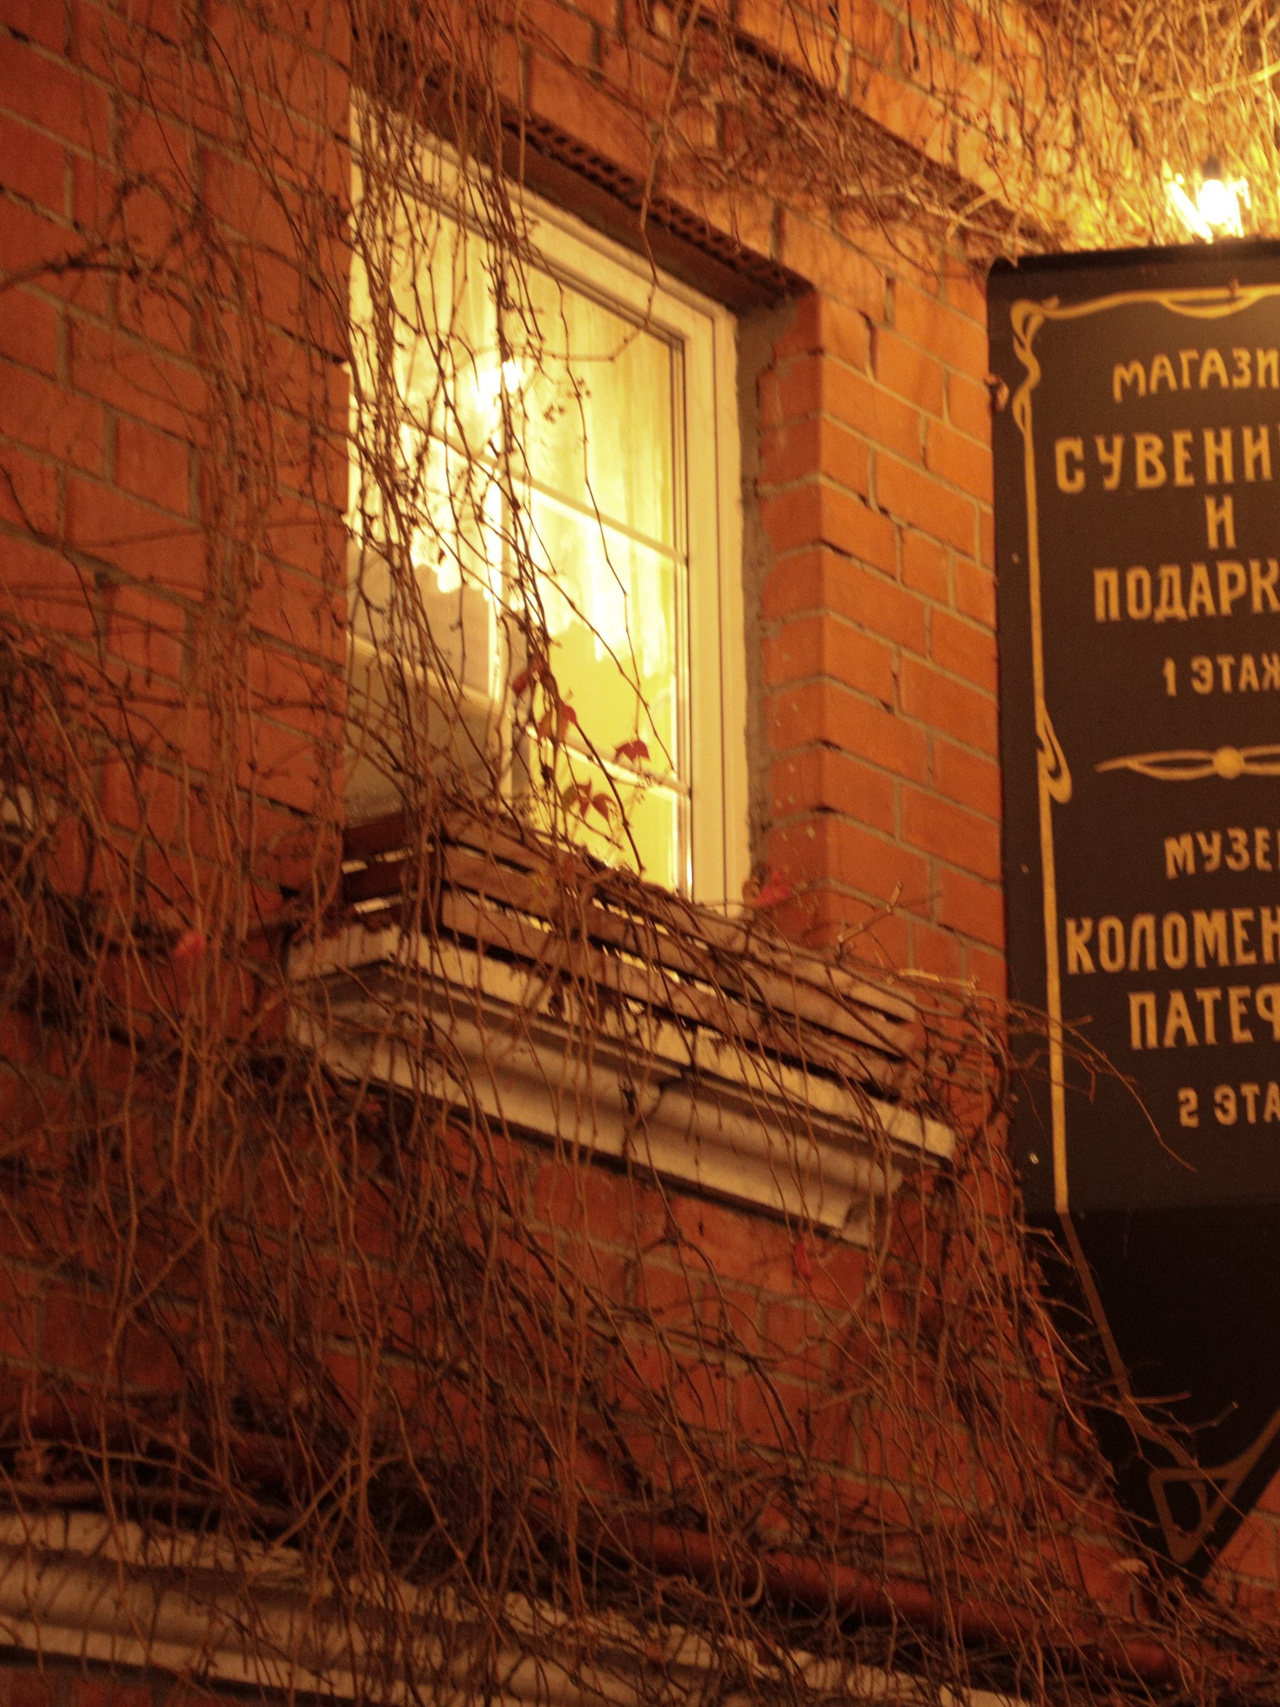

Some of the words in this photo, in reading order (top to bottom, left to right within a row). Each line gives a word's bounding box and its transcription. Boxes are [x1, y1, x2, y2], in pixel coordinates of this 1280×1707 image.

[1204, 495, 1236, 549] И
[1163, 656, 1177, 697] 1
[1177, 1087, 1200, 1128] 2
